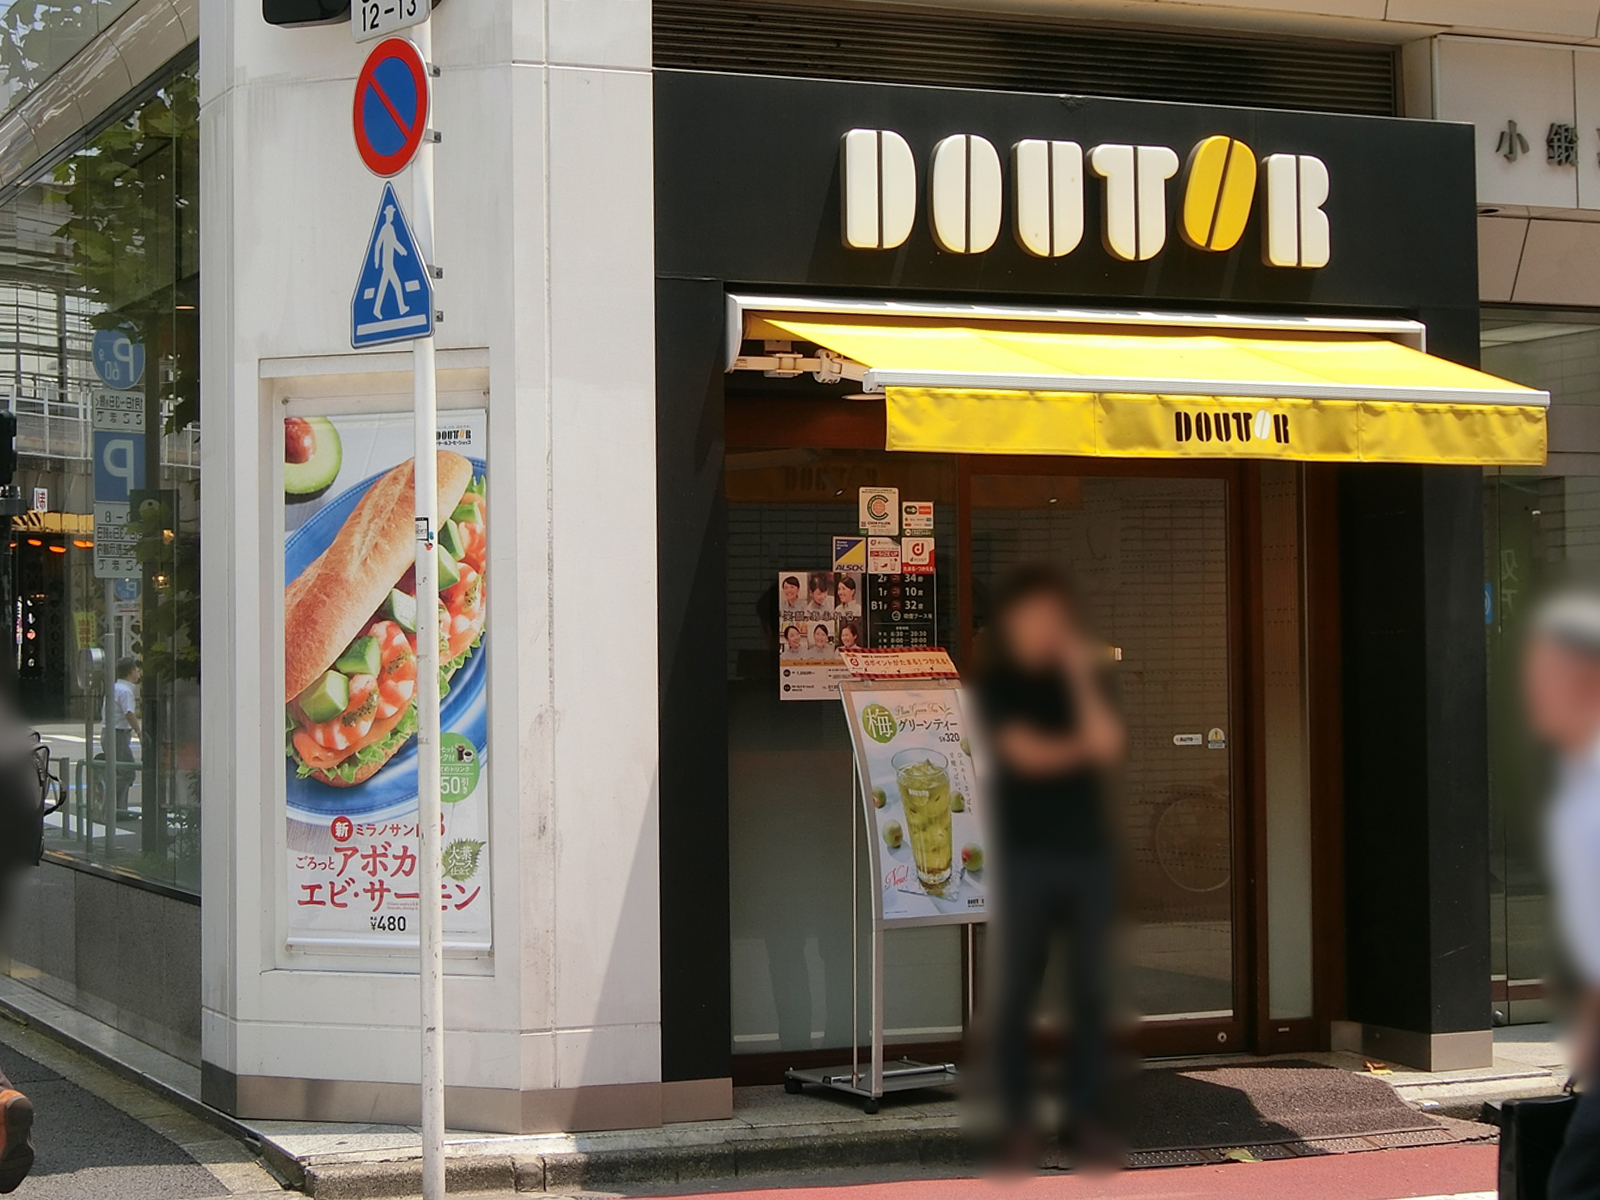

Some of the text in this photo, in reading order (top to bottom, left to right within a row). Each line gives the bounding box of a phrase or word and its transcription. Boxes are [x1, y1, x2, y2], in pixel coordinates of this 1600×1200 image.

[362, 0, 416, 32] 12-13
[841, 127, 1331, 269] DOUTOR
[1174, 408, 1290, 444] DOUTOR
[878, 587, 887, 597] 1F
[871, 600, 887, 610] B1F
[866, 708, 894, 738] 梅
[898, 719, 958, 732] グリーンティー
[335, 821, 349, 838] 新
[296, 841, 417, 877] ごろっと アボカ
[449, 846, 472, 859] 大葉
[448, 859, 473, 869] ソース
[370, 916, 406, 932] ¥480
